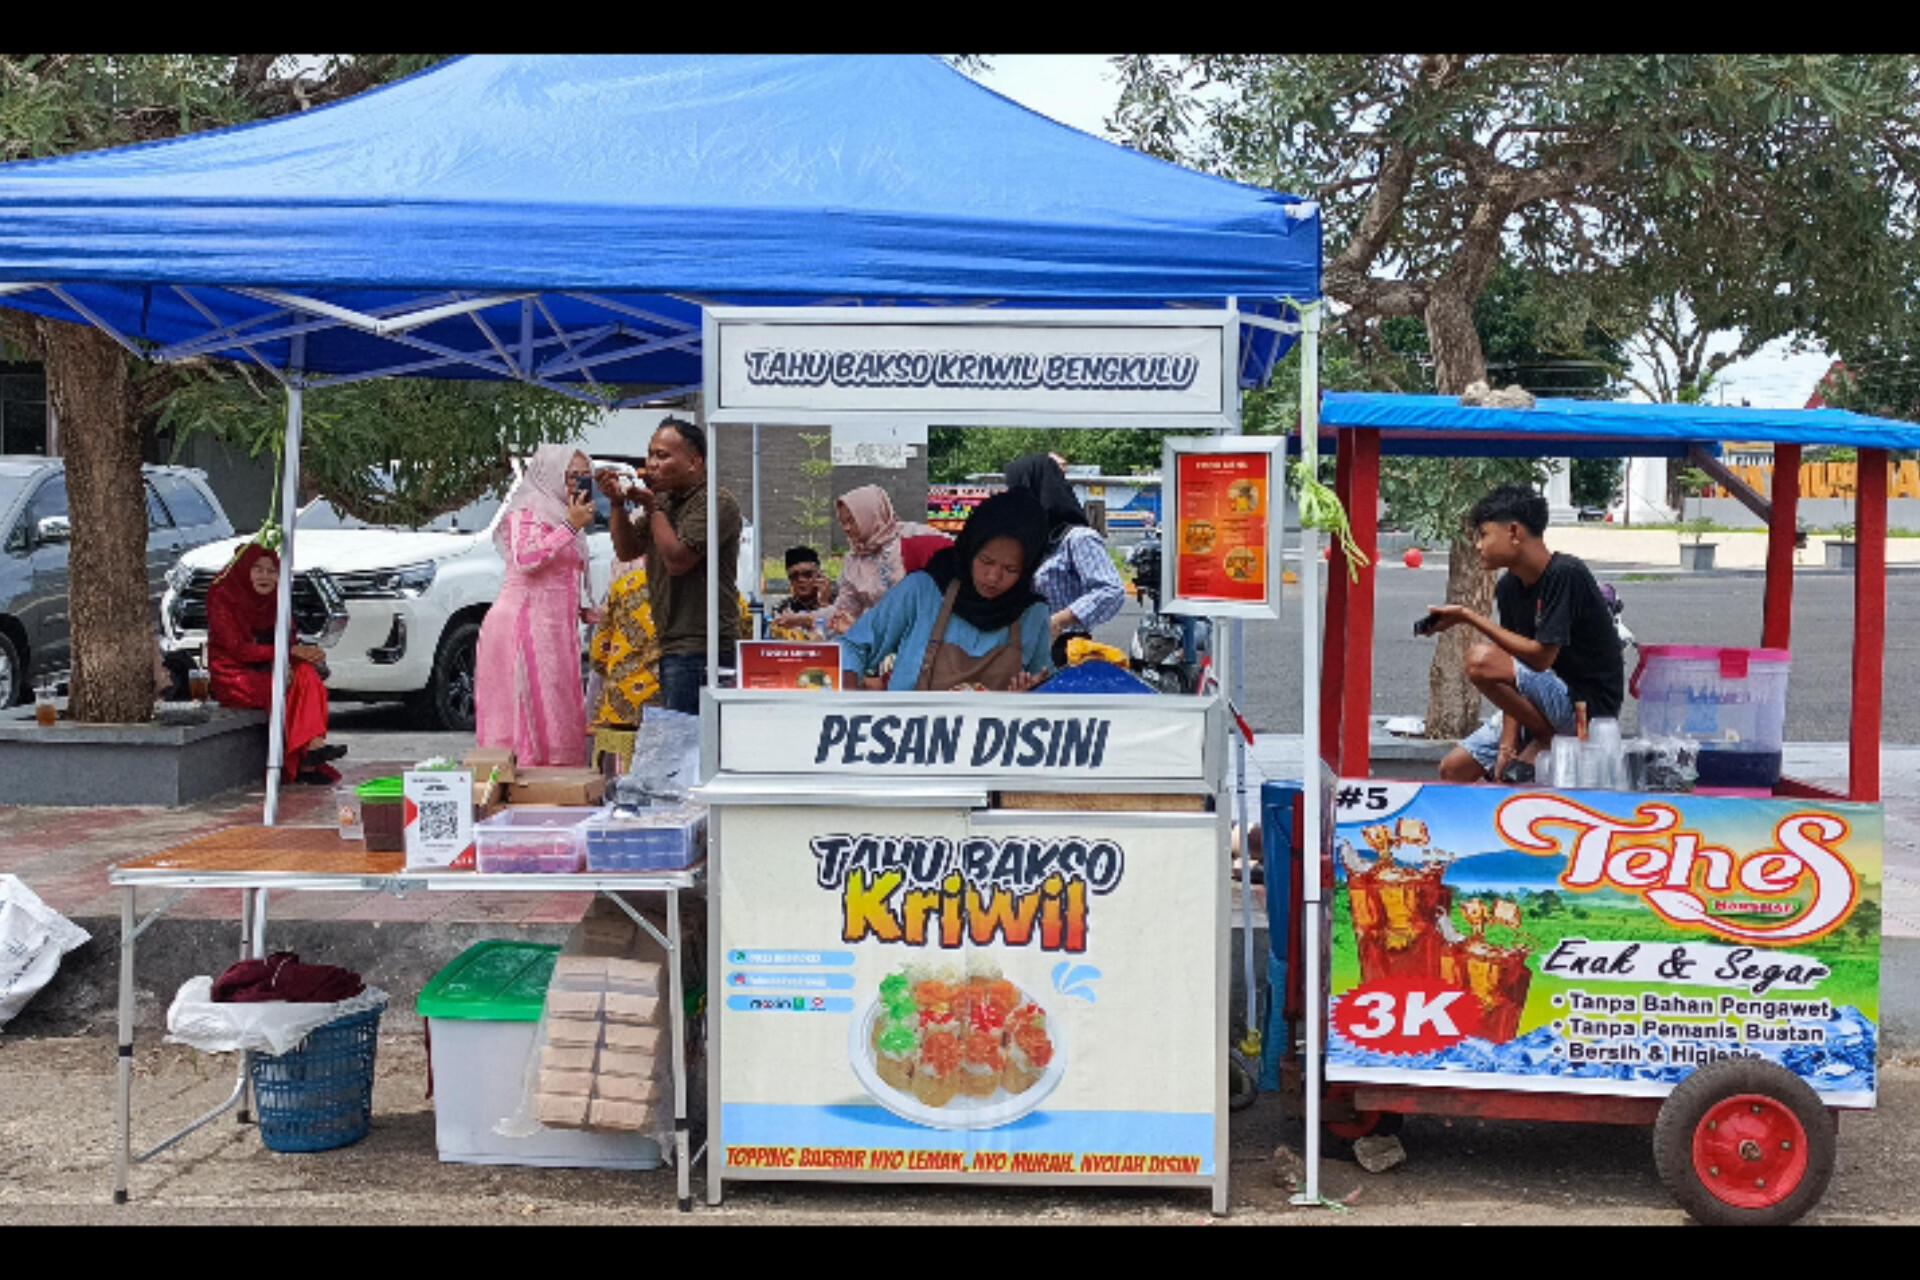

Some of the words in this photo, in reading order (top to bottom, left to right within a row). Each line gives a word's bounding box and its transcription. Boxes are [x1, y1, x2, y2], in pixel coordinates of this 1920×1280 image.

[746, 350, 829, 386] TAHU
[831, 351, 931, 388] BAKSO
[933, 353, 1042, 389] KRIWIL
[1043, 353, 1198, 391] BENGKULU
[814, 715, 964, 766] PESAN
[970, 717, 1111, 768] DISINI
[1336, 786, 1388, 810] #5
[810, 835, 951, 889] TAHU
[957, 836, 1125, 895] BAKSO
[842, 866, 1089, 952] Kriwil
[1543, 939, 1641, 973] Enak
[1658, 946, 1697, 979] &
[1714, 948, 1829, 994] Segar
[1349, 991, 1465, 1038] 3K
[1570, 993, 1635, 1014] Tanpa
[1642, 994, 1714, 1014] Bahan
[1720, 997, 1830, 1020] Pengawet
[1570, 1018, 1636, 1038] Tanpa
[1642, 1019, 1738, 1040] Pemanis
[1745, 1023, 1824, 1042] Buatan
[1569, 1043, 1640, 1061] Bersih
[1647, 1045, 1667, 1062] &
[726, 1147, 796, 1168] TOPPING
